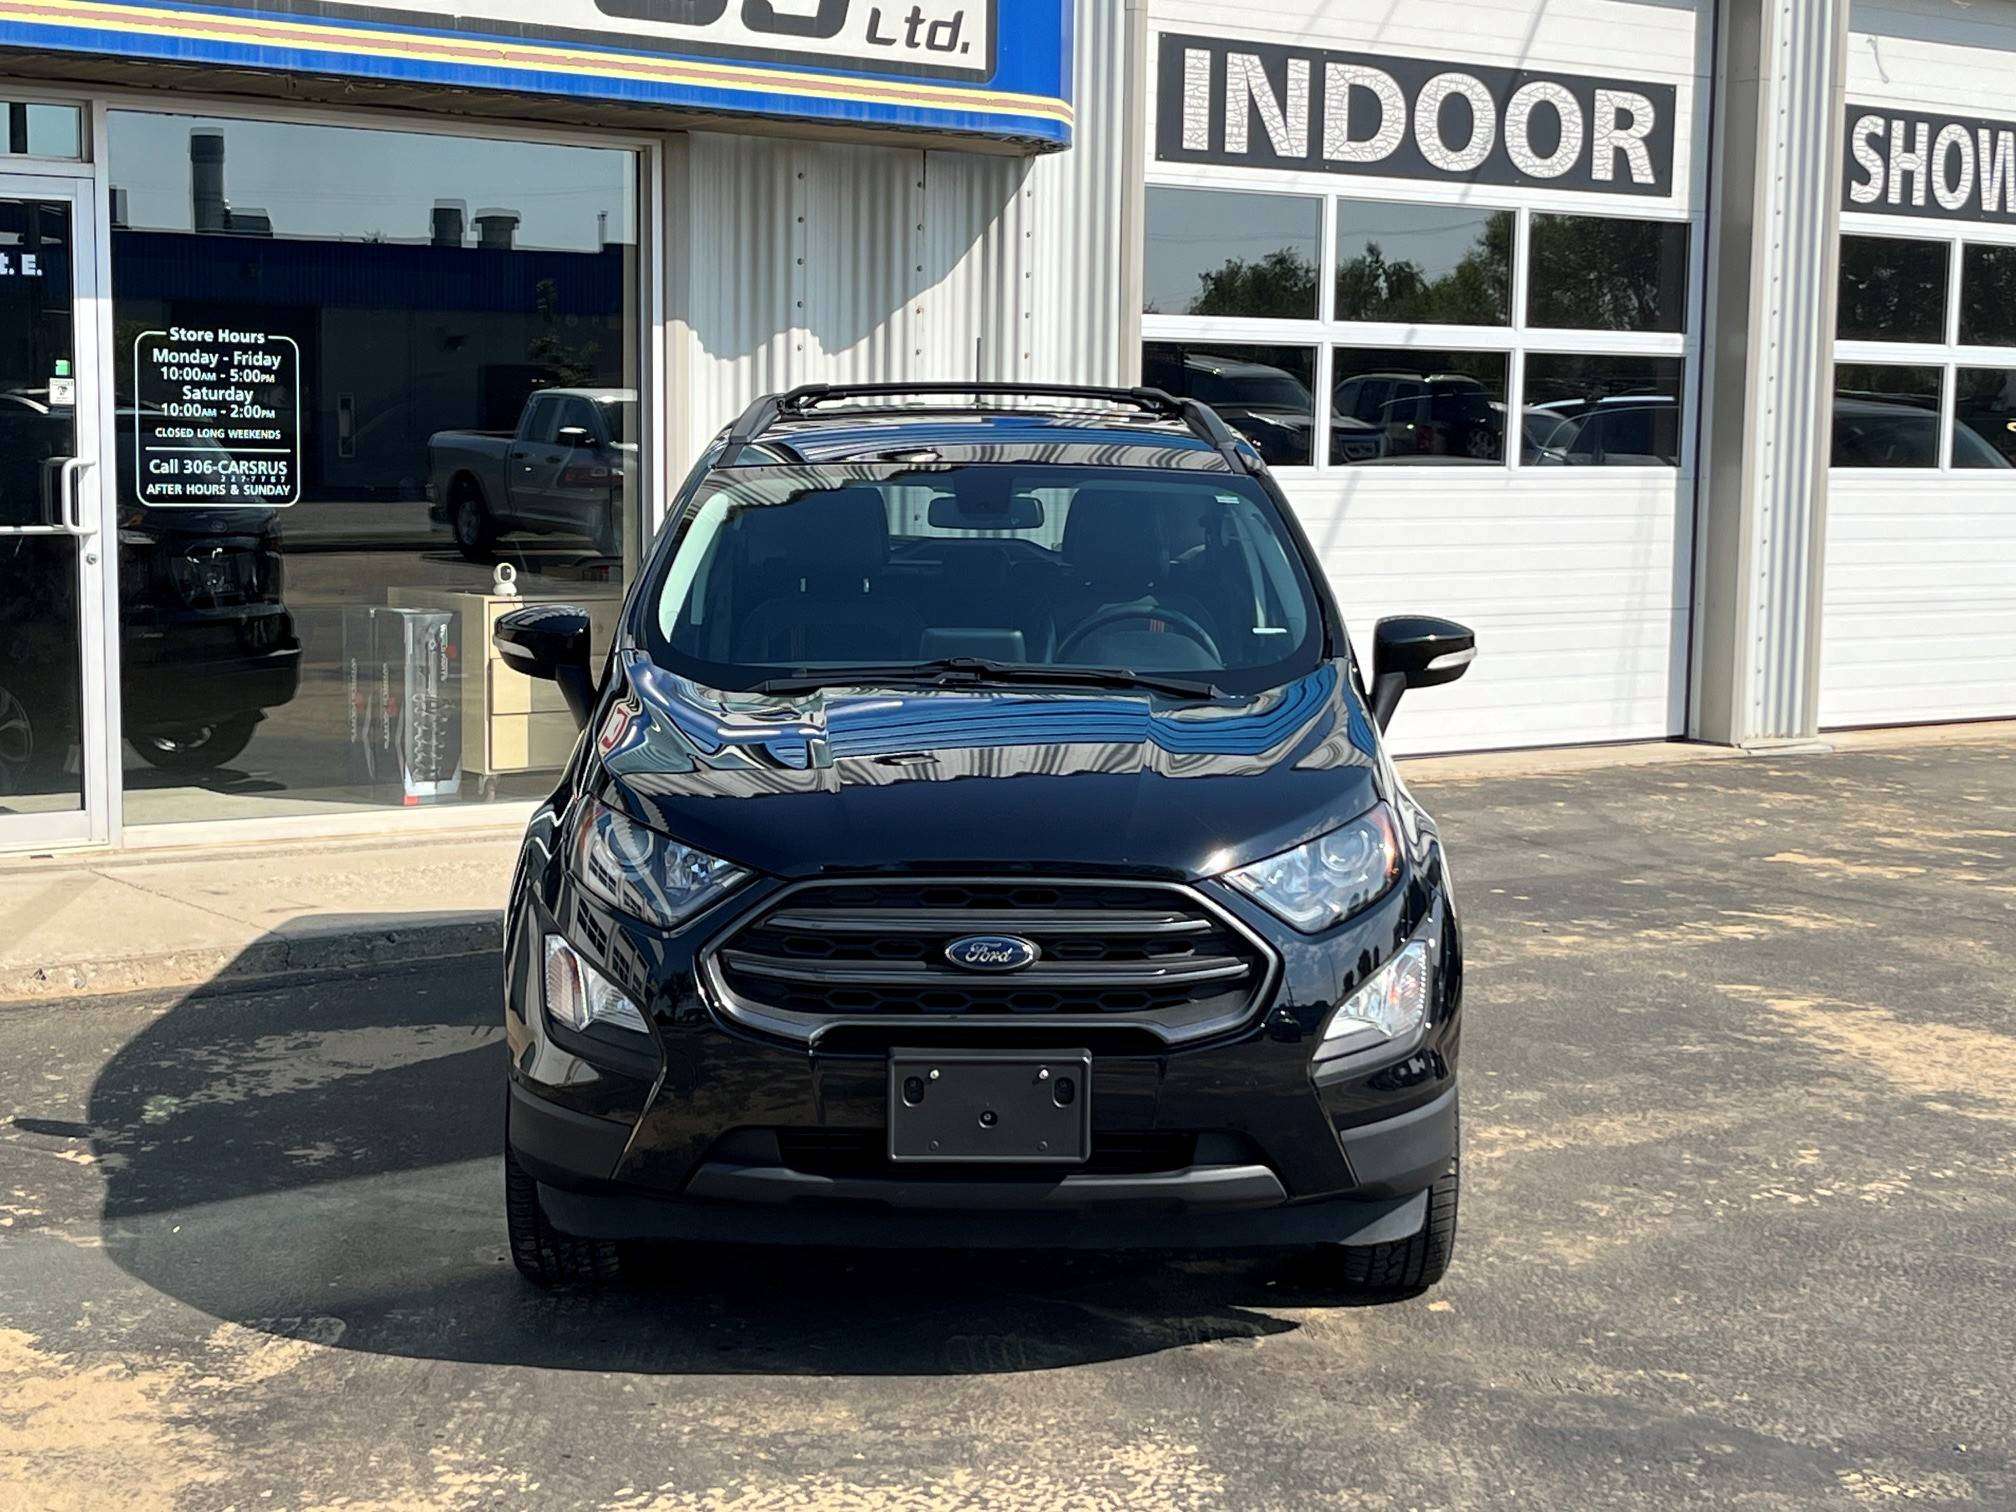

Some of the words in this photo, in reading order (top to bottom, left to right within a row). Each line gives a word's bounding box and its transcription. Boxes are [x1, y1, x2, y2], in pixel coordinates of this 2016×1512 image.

[865, 5, 970, 54] Ltd.
[1182, 47, 1657, 185] INDOOR
[21, 254, 43, 276] E.
[169, 327, 214, 342] Store
[218, 329, 265, 344] Hours
[153, 348, 219, 368] Monday
[233, 351, 281, 370] Friday
[161, 367, 217, 382] 10:00AM
[230, 369, 275, 383] 5:00PM
[182, 385, 254, 406] Saturday
[161, 403, 217, 418] 10:00AM
[230, 404, 275, 419] 2:00PM
[155, 427, 194, 438] CLOSED
[197, 428, 225, 438] LONG
[228, 429, 281, 440] WEEKENDS
[149, 458, 179, 474] Call
[183, 460, 288, 475] 306-CARSRUS
[146, 483, 183, 495] AFTER
[186, 484, 226, 495] HOURS
[230, 485, 239, 495] &
[243, 485, 291, 496] SUNDAY
[965, 942, 1012, 962] Ford
